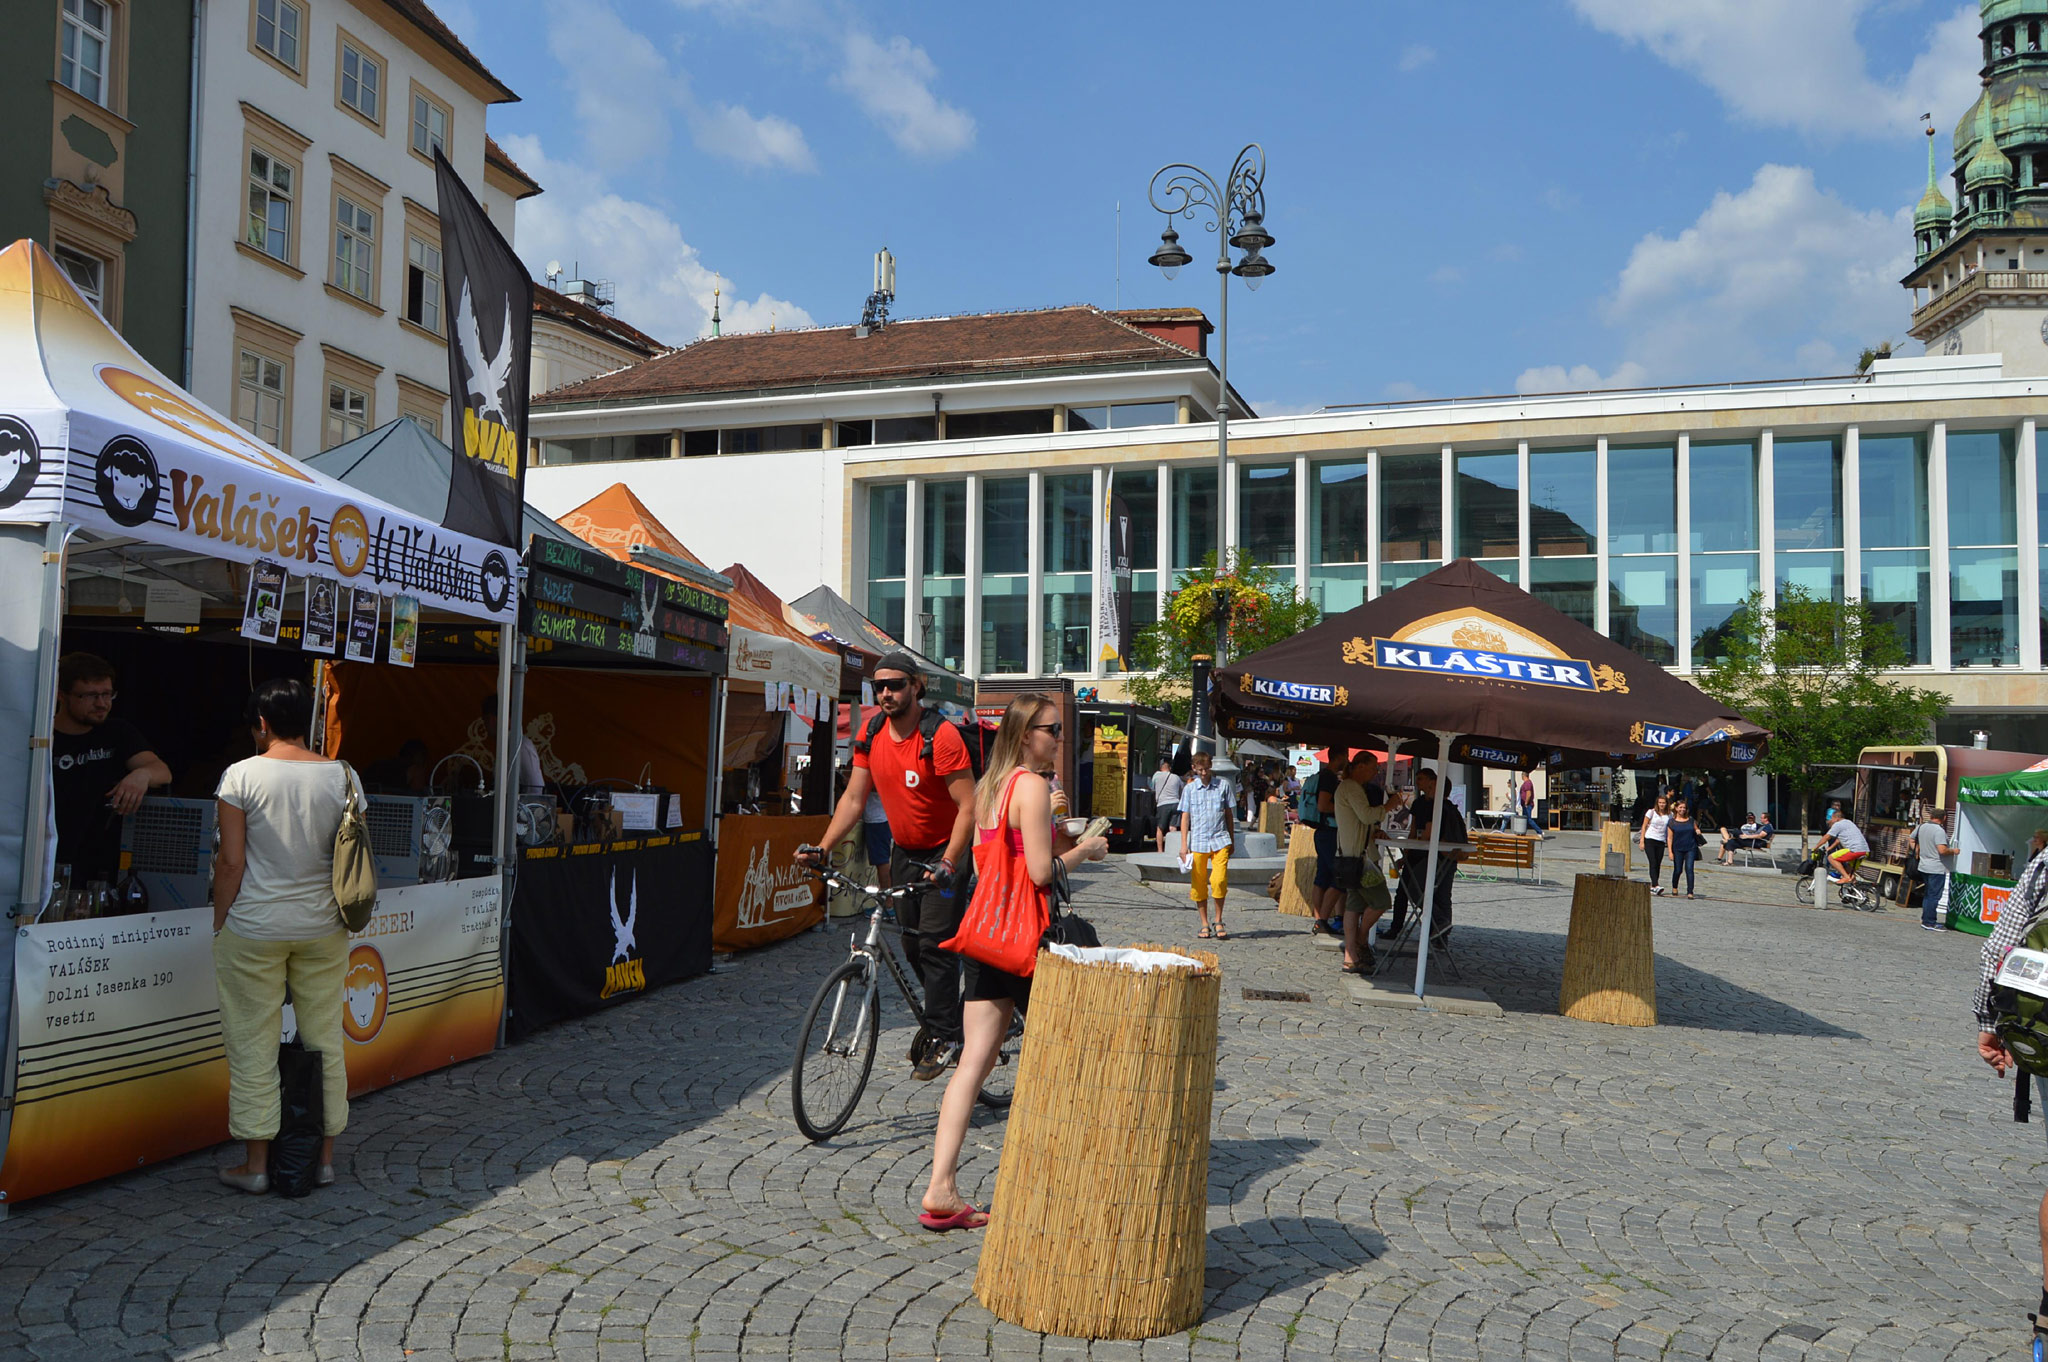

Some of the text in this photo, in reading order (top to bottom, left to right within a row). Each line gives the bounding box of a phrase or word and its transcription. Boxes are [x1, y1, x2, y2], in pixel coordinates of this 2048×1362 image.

[169, 468, 319, 563] Valášek
[539, 614, 577, 642] SUMMER
[1383, 645, 1587, 688] KLÁŠTER
[1253, 677, 1332, 703] KLÁŠTER
[47, 925, 192, 953] Rodinný minipivovar
[49, 957, 111, 978] VALÁŠEK
[600, 957, 646, 1000] RAVEN
[47, 971, 174, 1005] Dolní Jasenka 190
[46, 1009, 96, 1030] Vsetín
